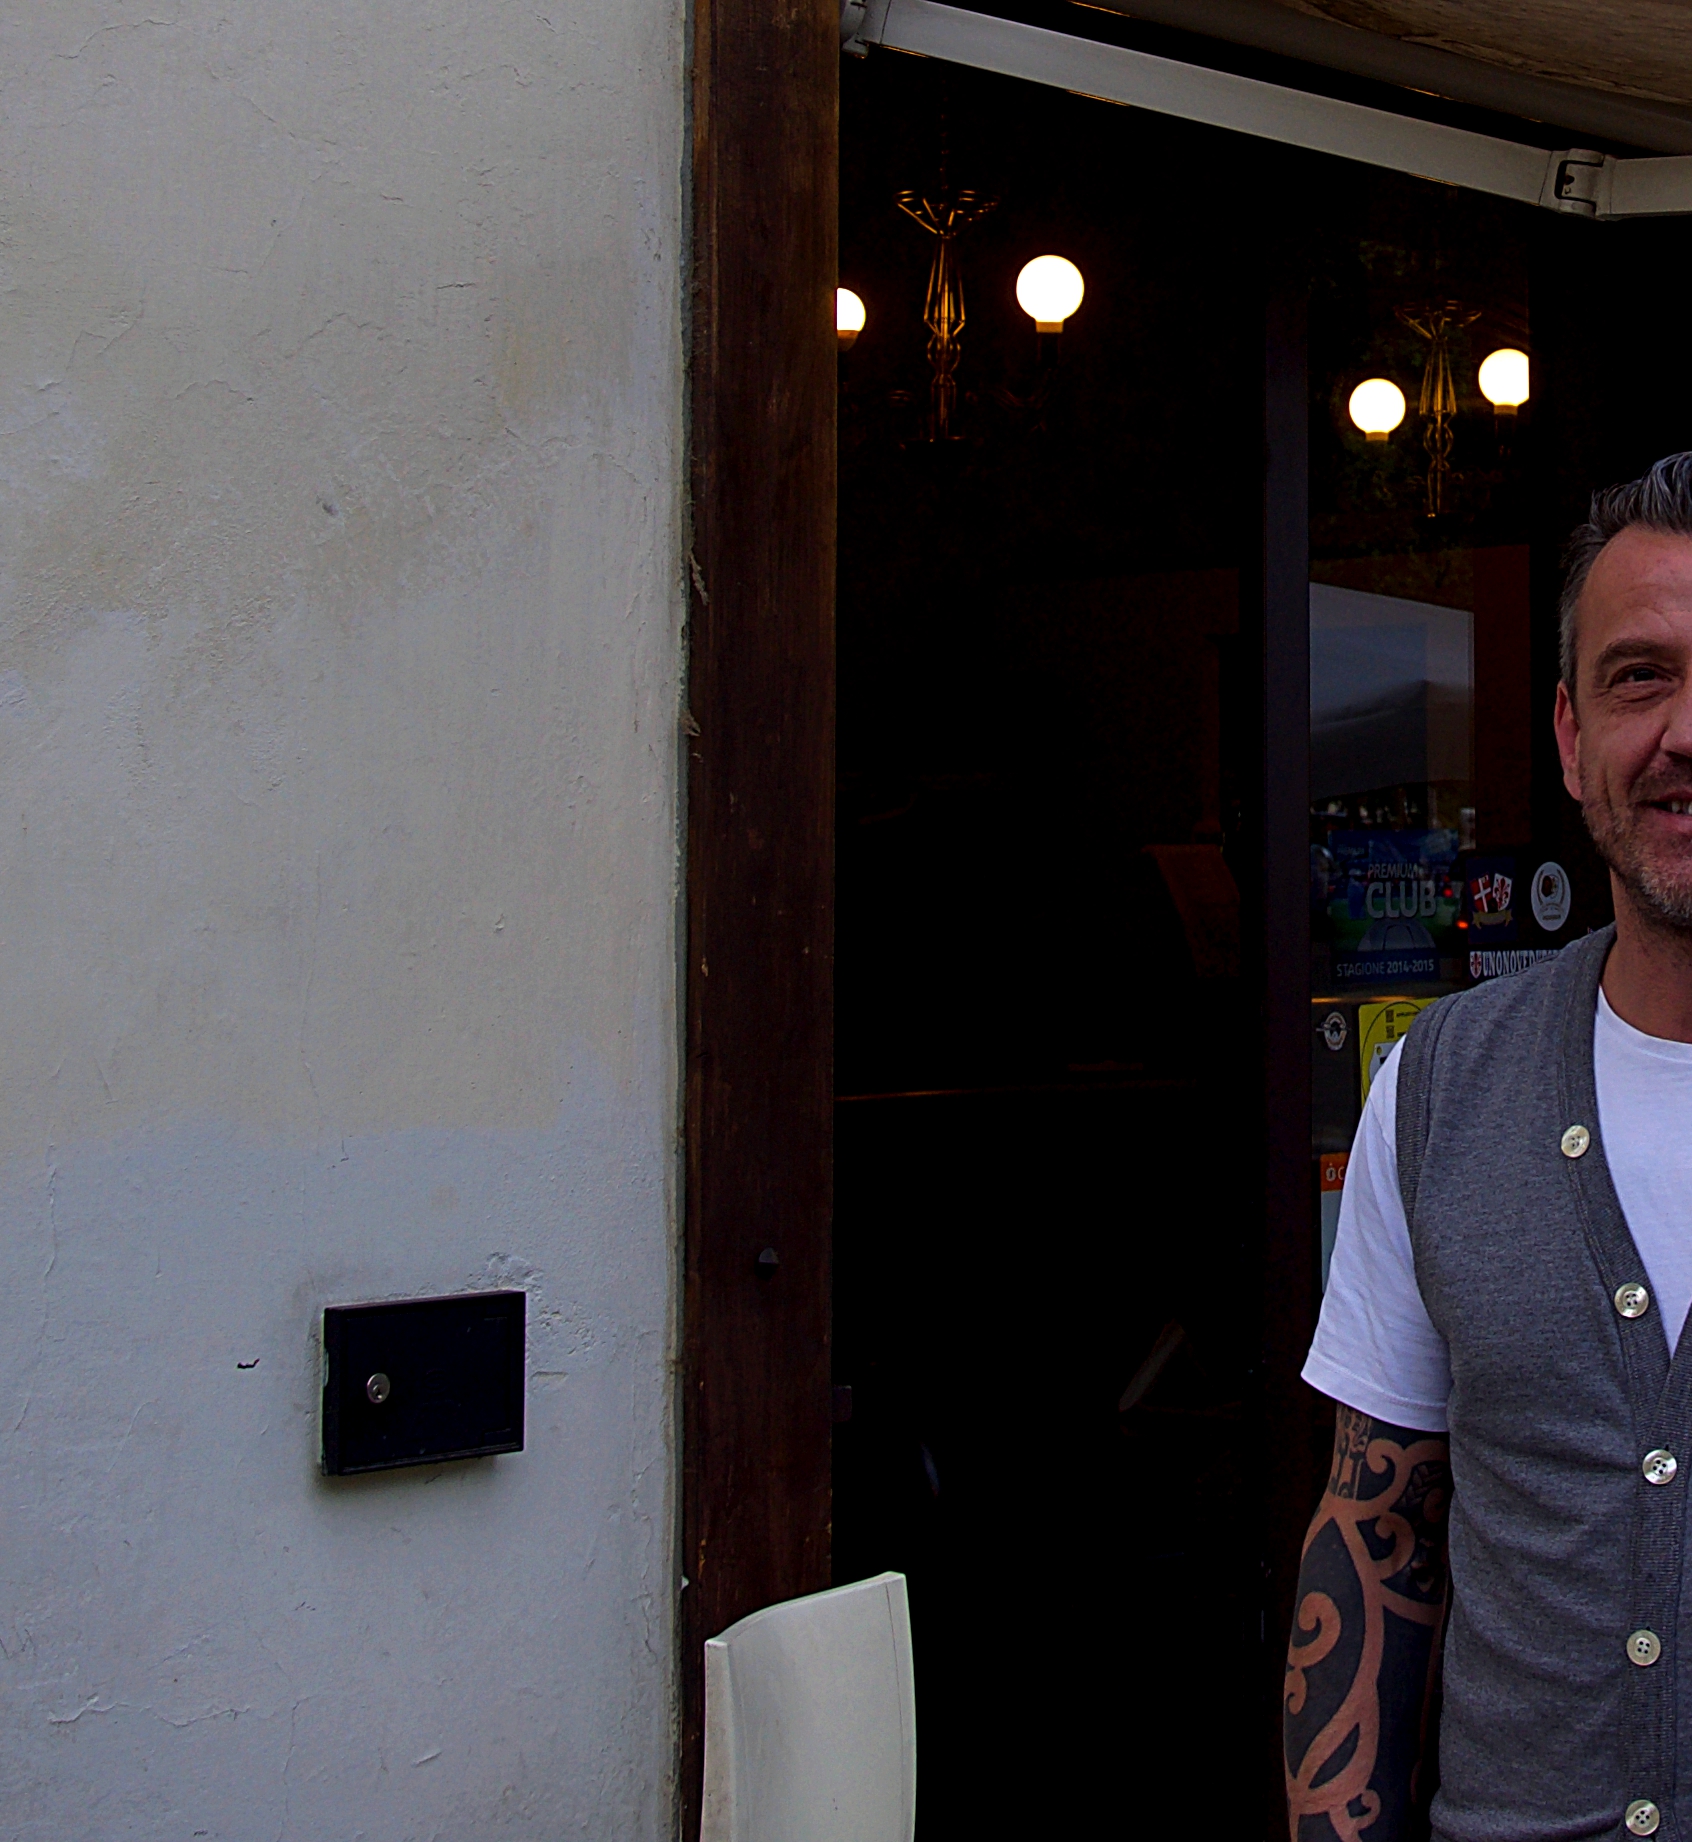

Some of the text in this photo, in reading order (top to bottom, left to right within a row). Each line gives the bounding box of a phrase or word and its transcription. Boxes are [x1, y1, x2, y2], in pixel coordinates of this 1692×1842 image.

[1367, 862, 1419, 879] PREMIUM
[1366, 881, 1436, 919] CLUB
[1336, 958, 1435, 977] STAGIONE 2014-2015
